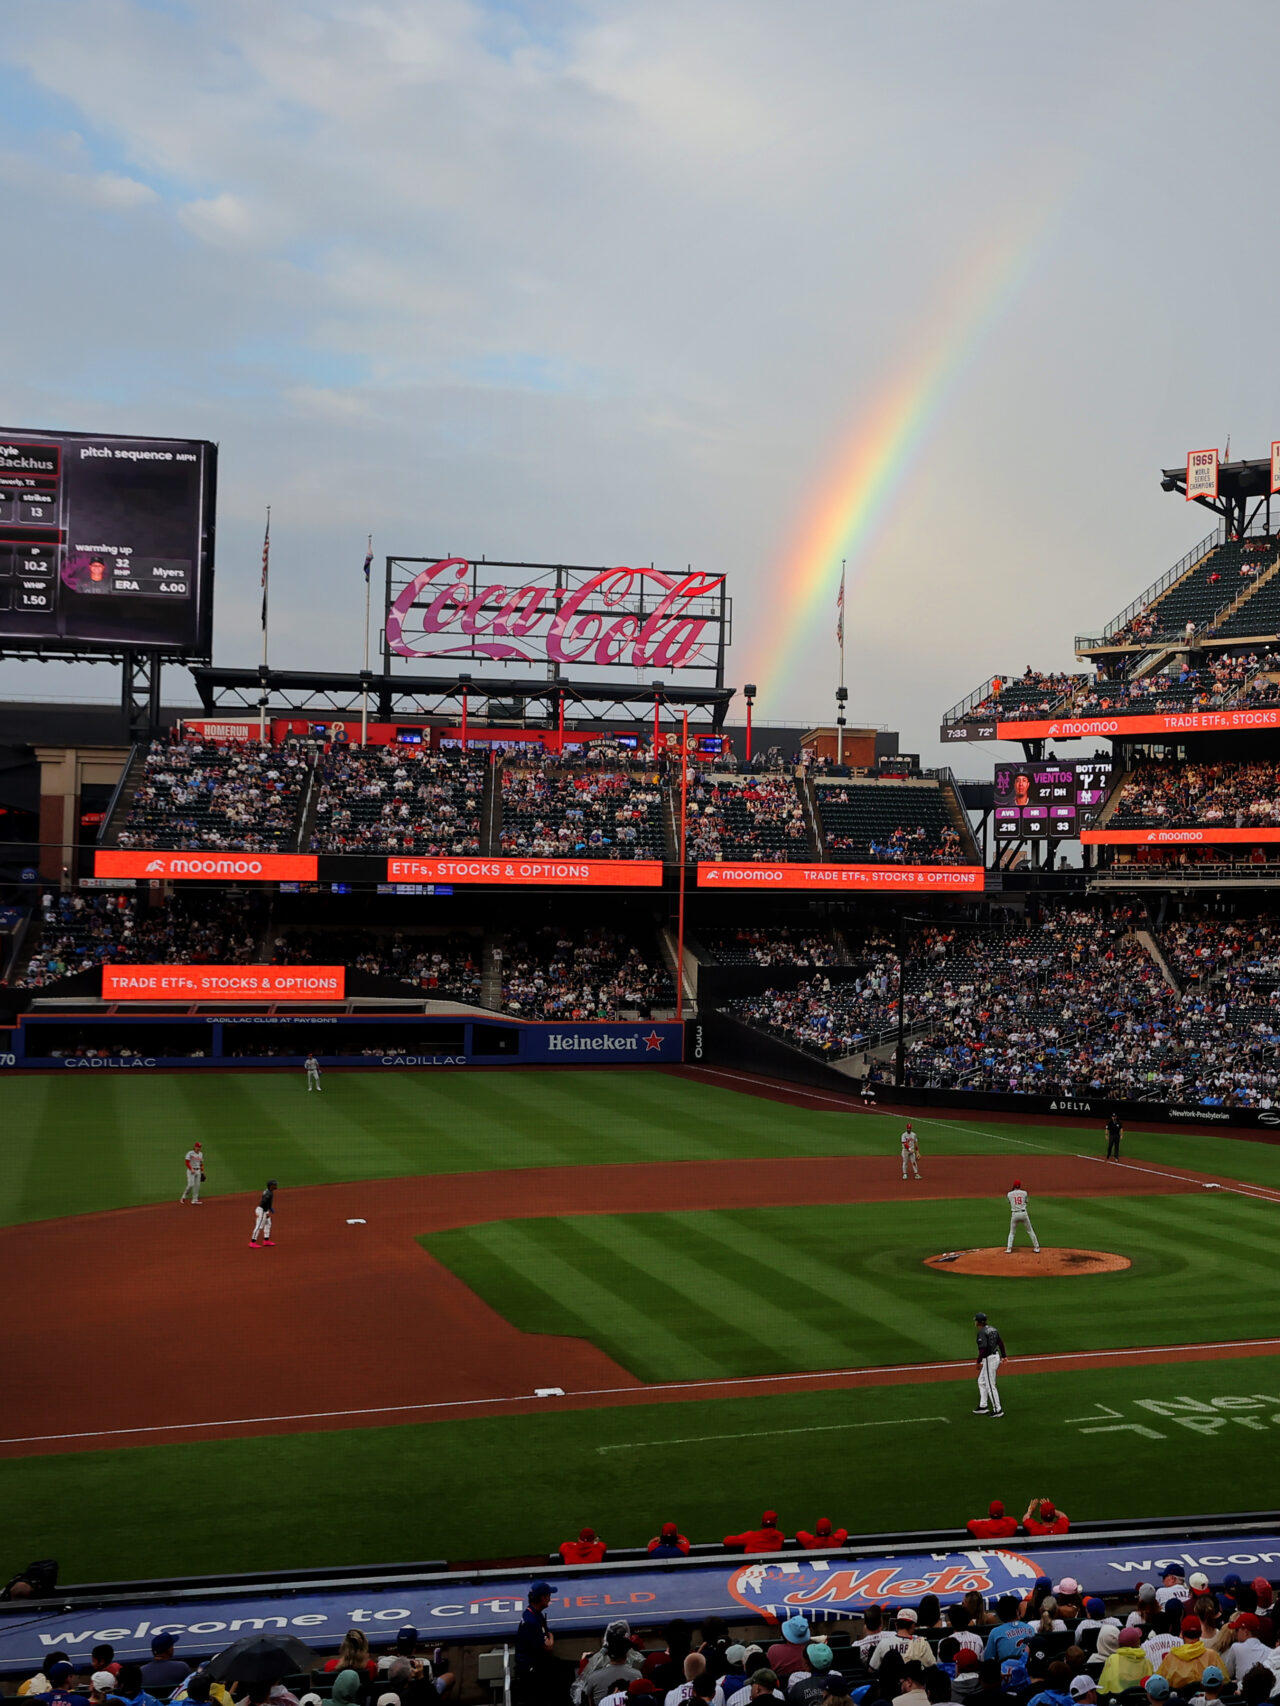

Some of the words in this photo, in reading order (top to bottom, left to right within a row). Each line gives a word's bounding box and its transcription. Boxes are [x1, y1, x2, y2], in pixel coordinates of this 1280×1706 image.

[80, 447, 112, 459] pitch
[114, 450, 173, 462] sequence
[176, 453, 197, 462] MPH
[1192, 454, 1213, 466] 1969
[1190, 482, 1214, 490] CHAMPIONS
[23, 494, 52, 502] strikes
[31, 507, 43, 517] 13
[75, 544, 118, 555] warming
[119, 546, 133, 555] up
[24, 561, 47, 571] 10.2
[115, 559, 130, 568] 32
[152, 567, 185, 578] Myers
[23, 582, 46, 590] WHIP
[115, 580, 139, 591] ERA
[159, 583, 186, 593] 6.00
[23, 595, 46, 606] 1.50
[386, 558, 727, 668] Coca-Cola
[1062, 721, 1118, 733] moomoo
[1164, 716, 1198, 728] TRADE
[1201, 715, 1229, 727] ETFs,
[1232, 712, 1277, 725] STOCKS
[204, 724, 249, 737] HOMERUN
[947, 729, 967, 738] 7:33
[1076, 765, 1093, 773] BOT
[1095, 764, 1112, 772] 7TH
[1033, 772, 1073, 783] VIENTOS
[1100, 775, 1105, 787] 2
[1054, 788, 1066, 796] DH
[999, 823, 1016, 831] .215
[1030, 823, 1040, 831] 10
[1057, 822, 1069, 830] 33
[1158, 831, 1203, 842] moomoo
[170, 860, 262, 874] moomoo
[392, 862, 433, 876] ETFs,
[437, 863, 501, 877] STOCKS
[505, 865, 517, 877] &
[520, 864, 590, 878] OPTIONS
[722, 869, 783, 881] moomoo
[804, 870, 839, 882] TRADE
[842, 871, 869, 883] ETFs,
[872, 872, 915, 884] STOCKS
[918, 873, 926, 884] &
[928, 872, 976, 884] OPTIONS
[111, 977, 158, 988] TRADE
[161, 977, 197, 990] ETFs,
[201, 977, 258, 989] STOCKS
[262, 977, 271, 988] &
[274, 977, 337, 989] OPTIONS
[548, 1034, 637, 1051] Heineken
[64, 1058, 156, 1067] CADILLAC
[381, 1056, 467, 1065] CADILLAC
[1060, 1102, 1091, 1111] DELTA
[784, 1566, 993, 1605] Mets
[38, 1613, 327, 1647] welcome
[346, 1603, 409, 1624] to
[430, 1597, 524, 1617] citi
[1149, 1640, 1180, 1653] HOWARD
